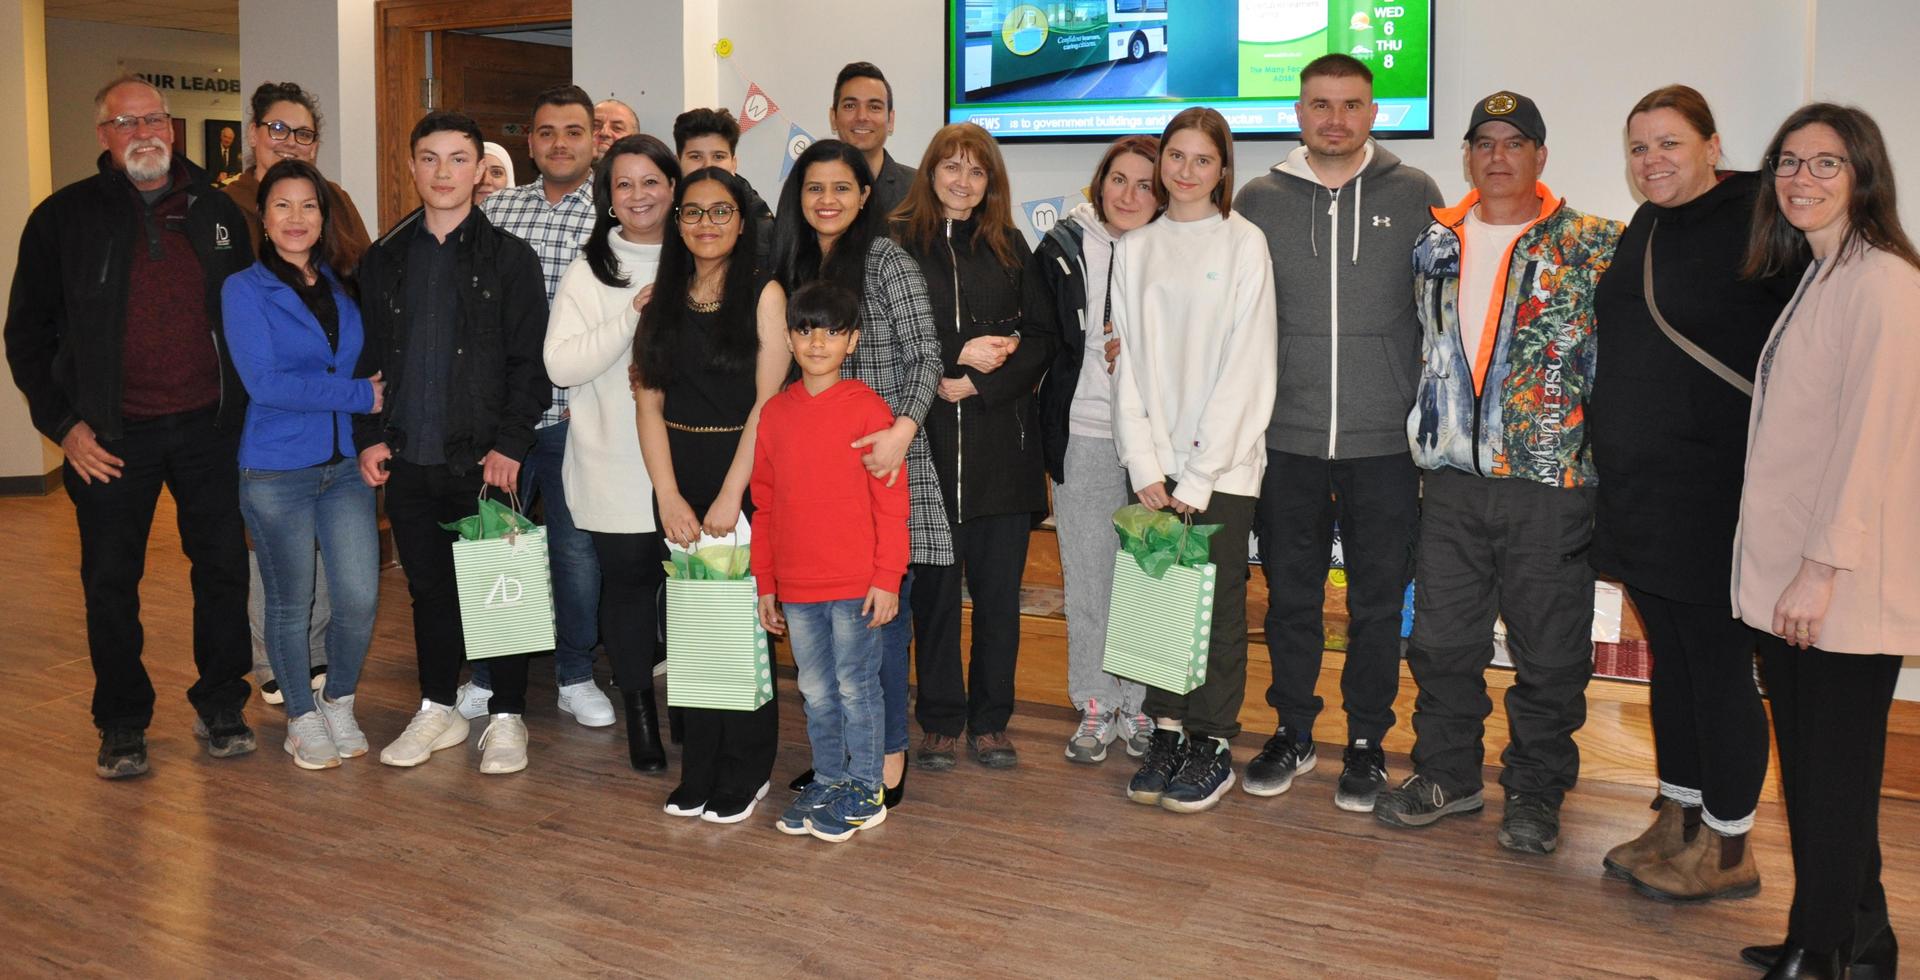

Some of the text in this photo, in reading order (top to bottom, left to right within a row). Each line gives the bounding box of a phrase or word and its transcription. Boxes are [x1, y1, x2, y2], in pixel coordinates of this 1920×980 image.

[1374, 6, 1404, 18] WED
[1383, 21, 1395, 35] 6
[1376, 40, 1403, 51] THU
[1383, 54, 1394, 69] 8
[971, 117, 1000, 130] NEWS
[1021, 118, 1031, 129] to
[1033, 115, 1094, 130] government
[1095, 112, 1143, 128] buildings
[1145, 113, 1166, 126] and
[1035, 209, 1056, 227] m
